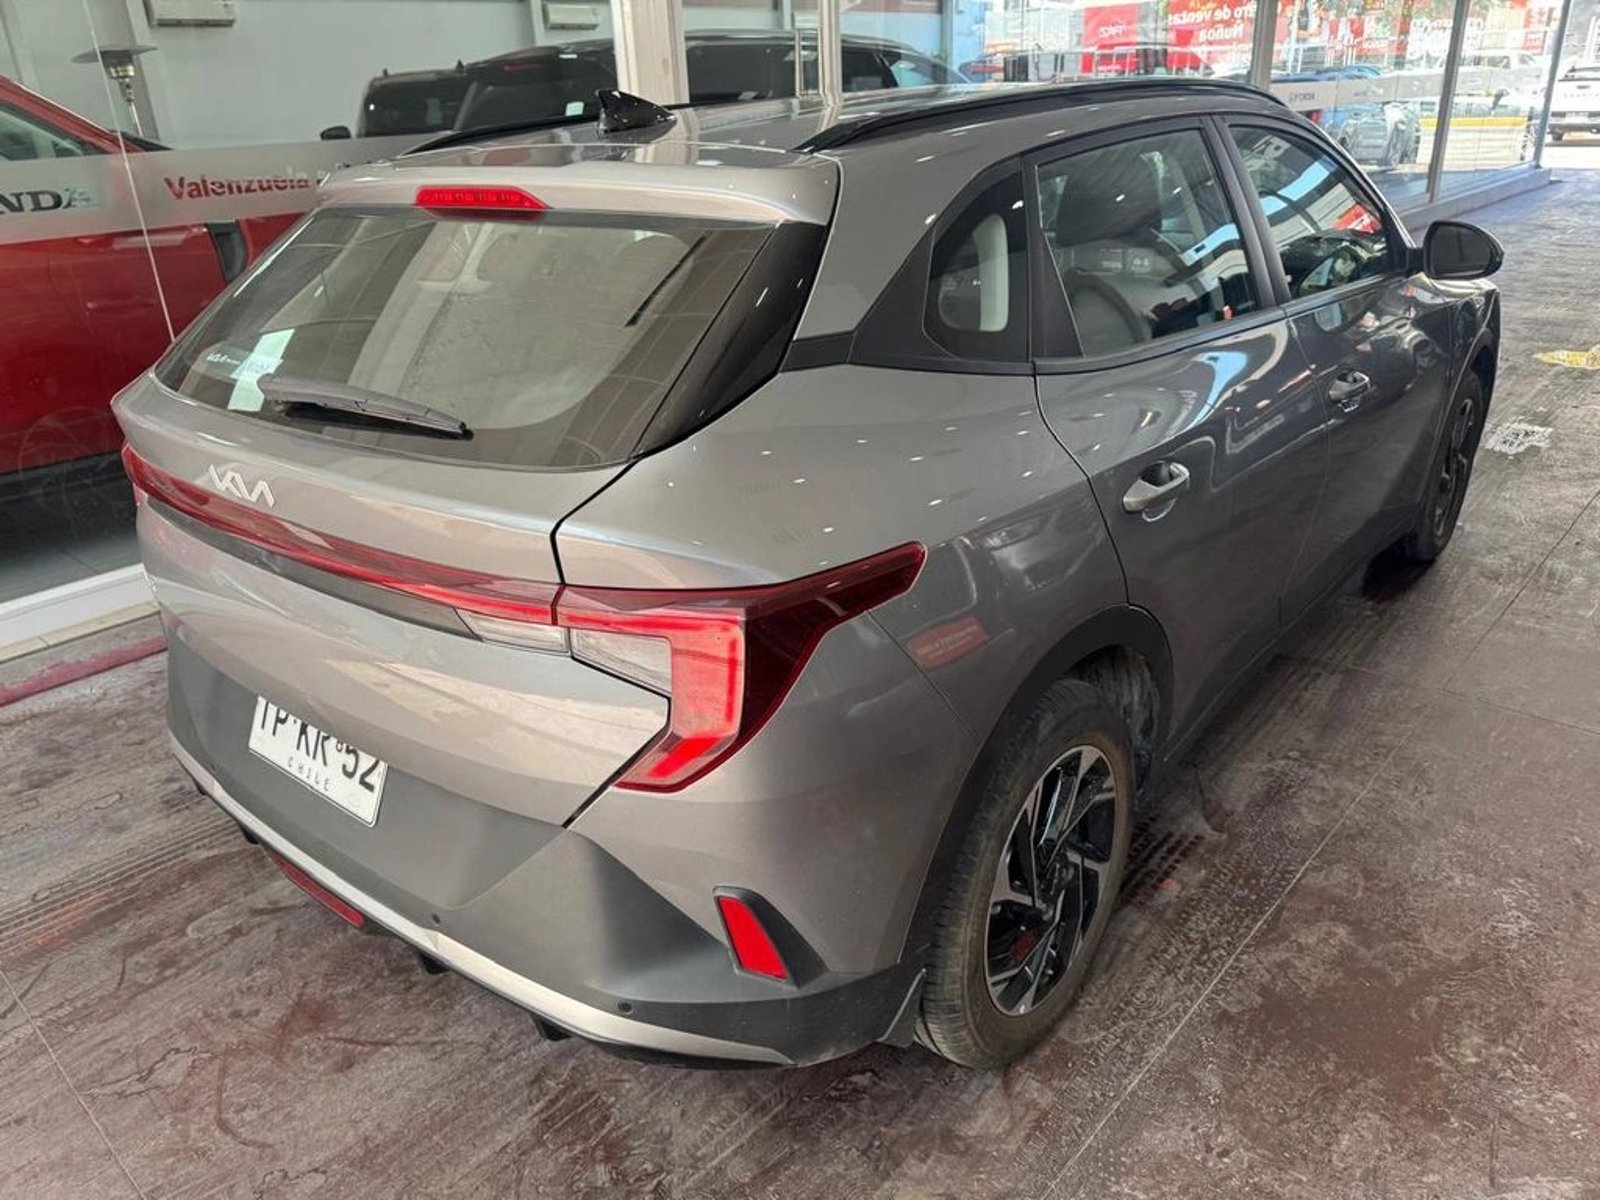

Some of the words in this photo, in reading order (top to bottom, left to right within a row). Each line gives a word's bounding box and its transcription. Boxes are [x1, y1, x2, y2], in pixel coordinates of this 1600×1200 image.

[164, 166, 310, 200] Valenzuela
[208, 463, 275, 508] KIA
[286, 756, 331, 792] CHILE
